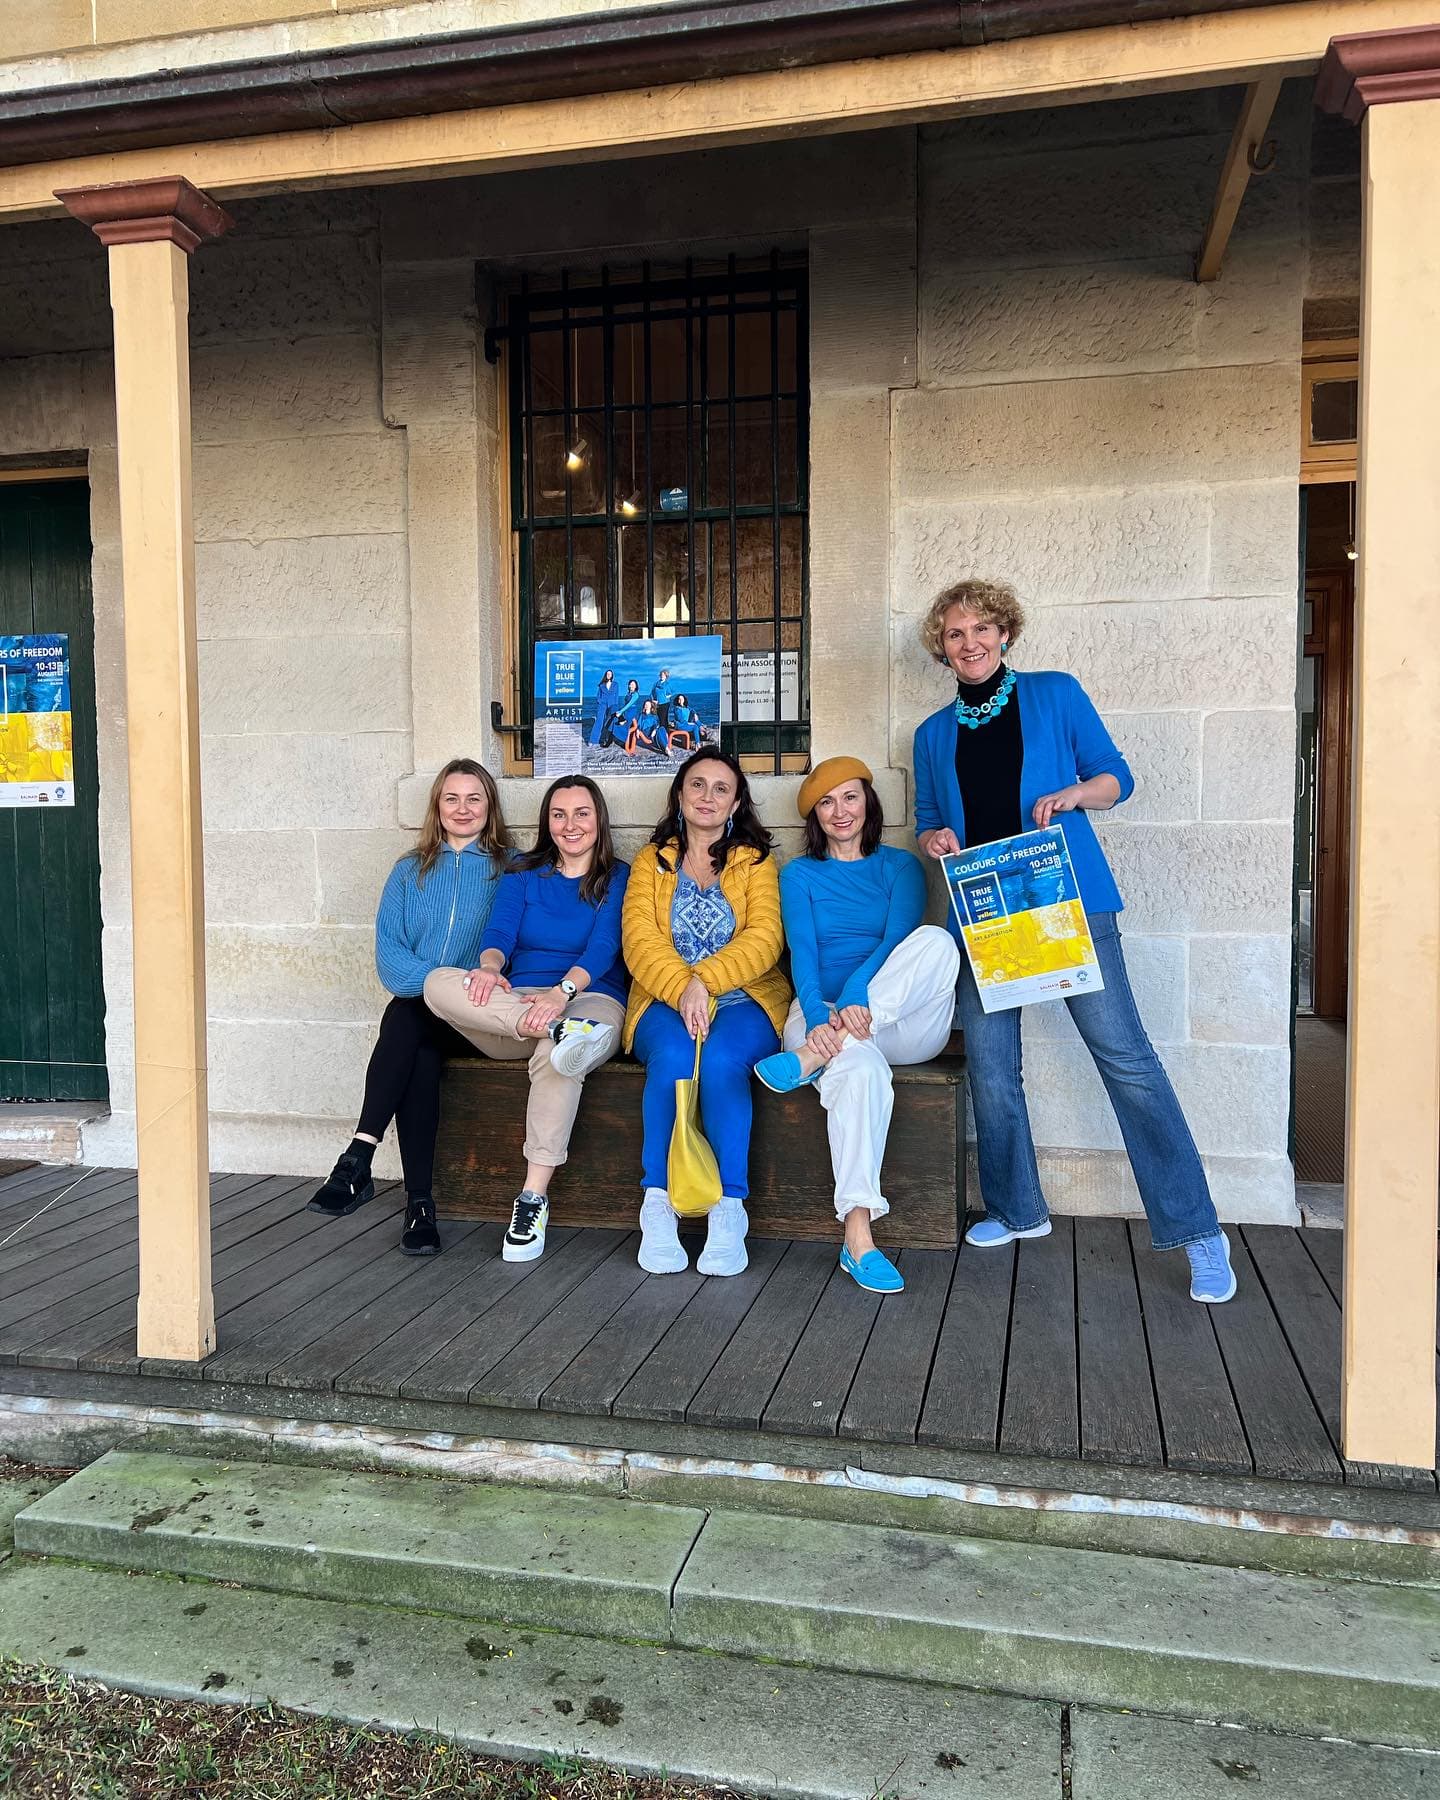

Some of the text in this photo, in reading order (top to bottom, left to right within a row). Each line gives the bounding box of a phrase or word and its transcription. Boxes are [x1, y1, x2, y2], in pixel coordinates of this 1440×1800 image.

[10, 649, 21, 658] OF
[23, 647, 63, 658] FREEDOM
[35, 661, 57, 671] 10-13
[555, 663, 576, 671] TRUE
[722, 659, 797, 668] ALAIN ASSOCTION
[555, 672, 575, 681] BLUE
[555, 687, 575, 695] yellow
[546, 708, 583, 716] ARTIST
[954, 841, 1058, 875] COLOURS OF FREEDOM
[1029, 856, 1054, 869] 10-13
[970, 886, 993, 898] TRUE
[973, 895, 996, 907] BLUE
[977, 910, 998, 921] yellow
[984, 928, 1013, 939] EXHIBITION
